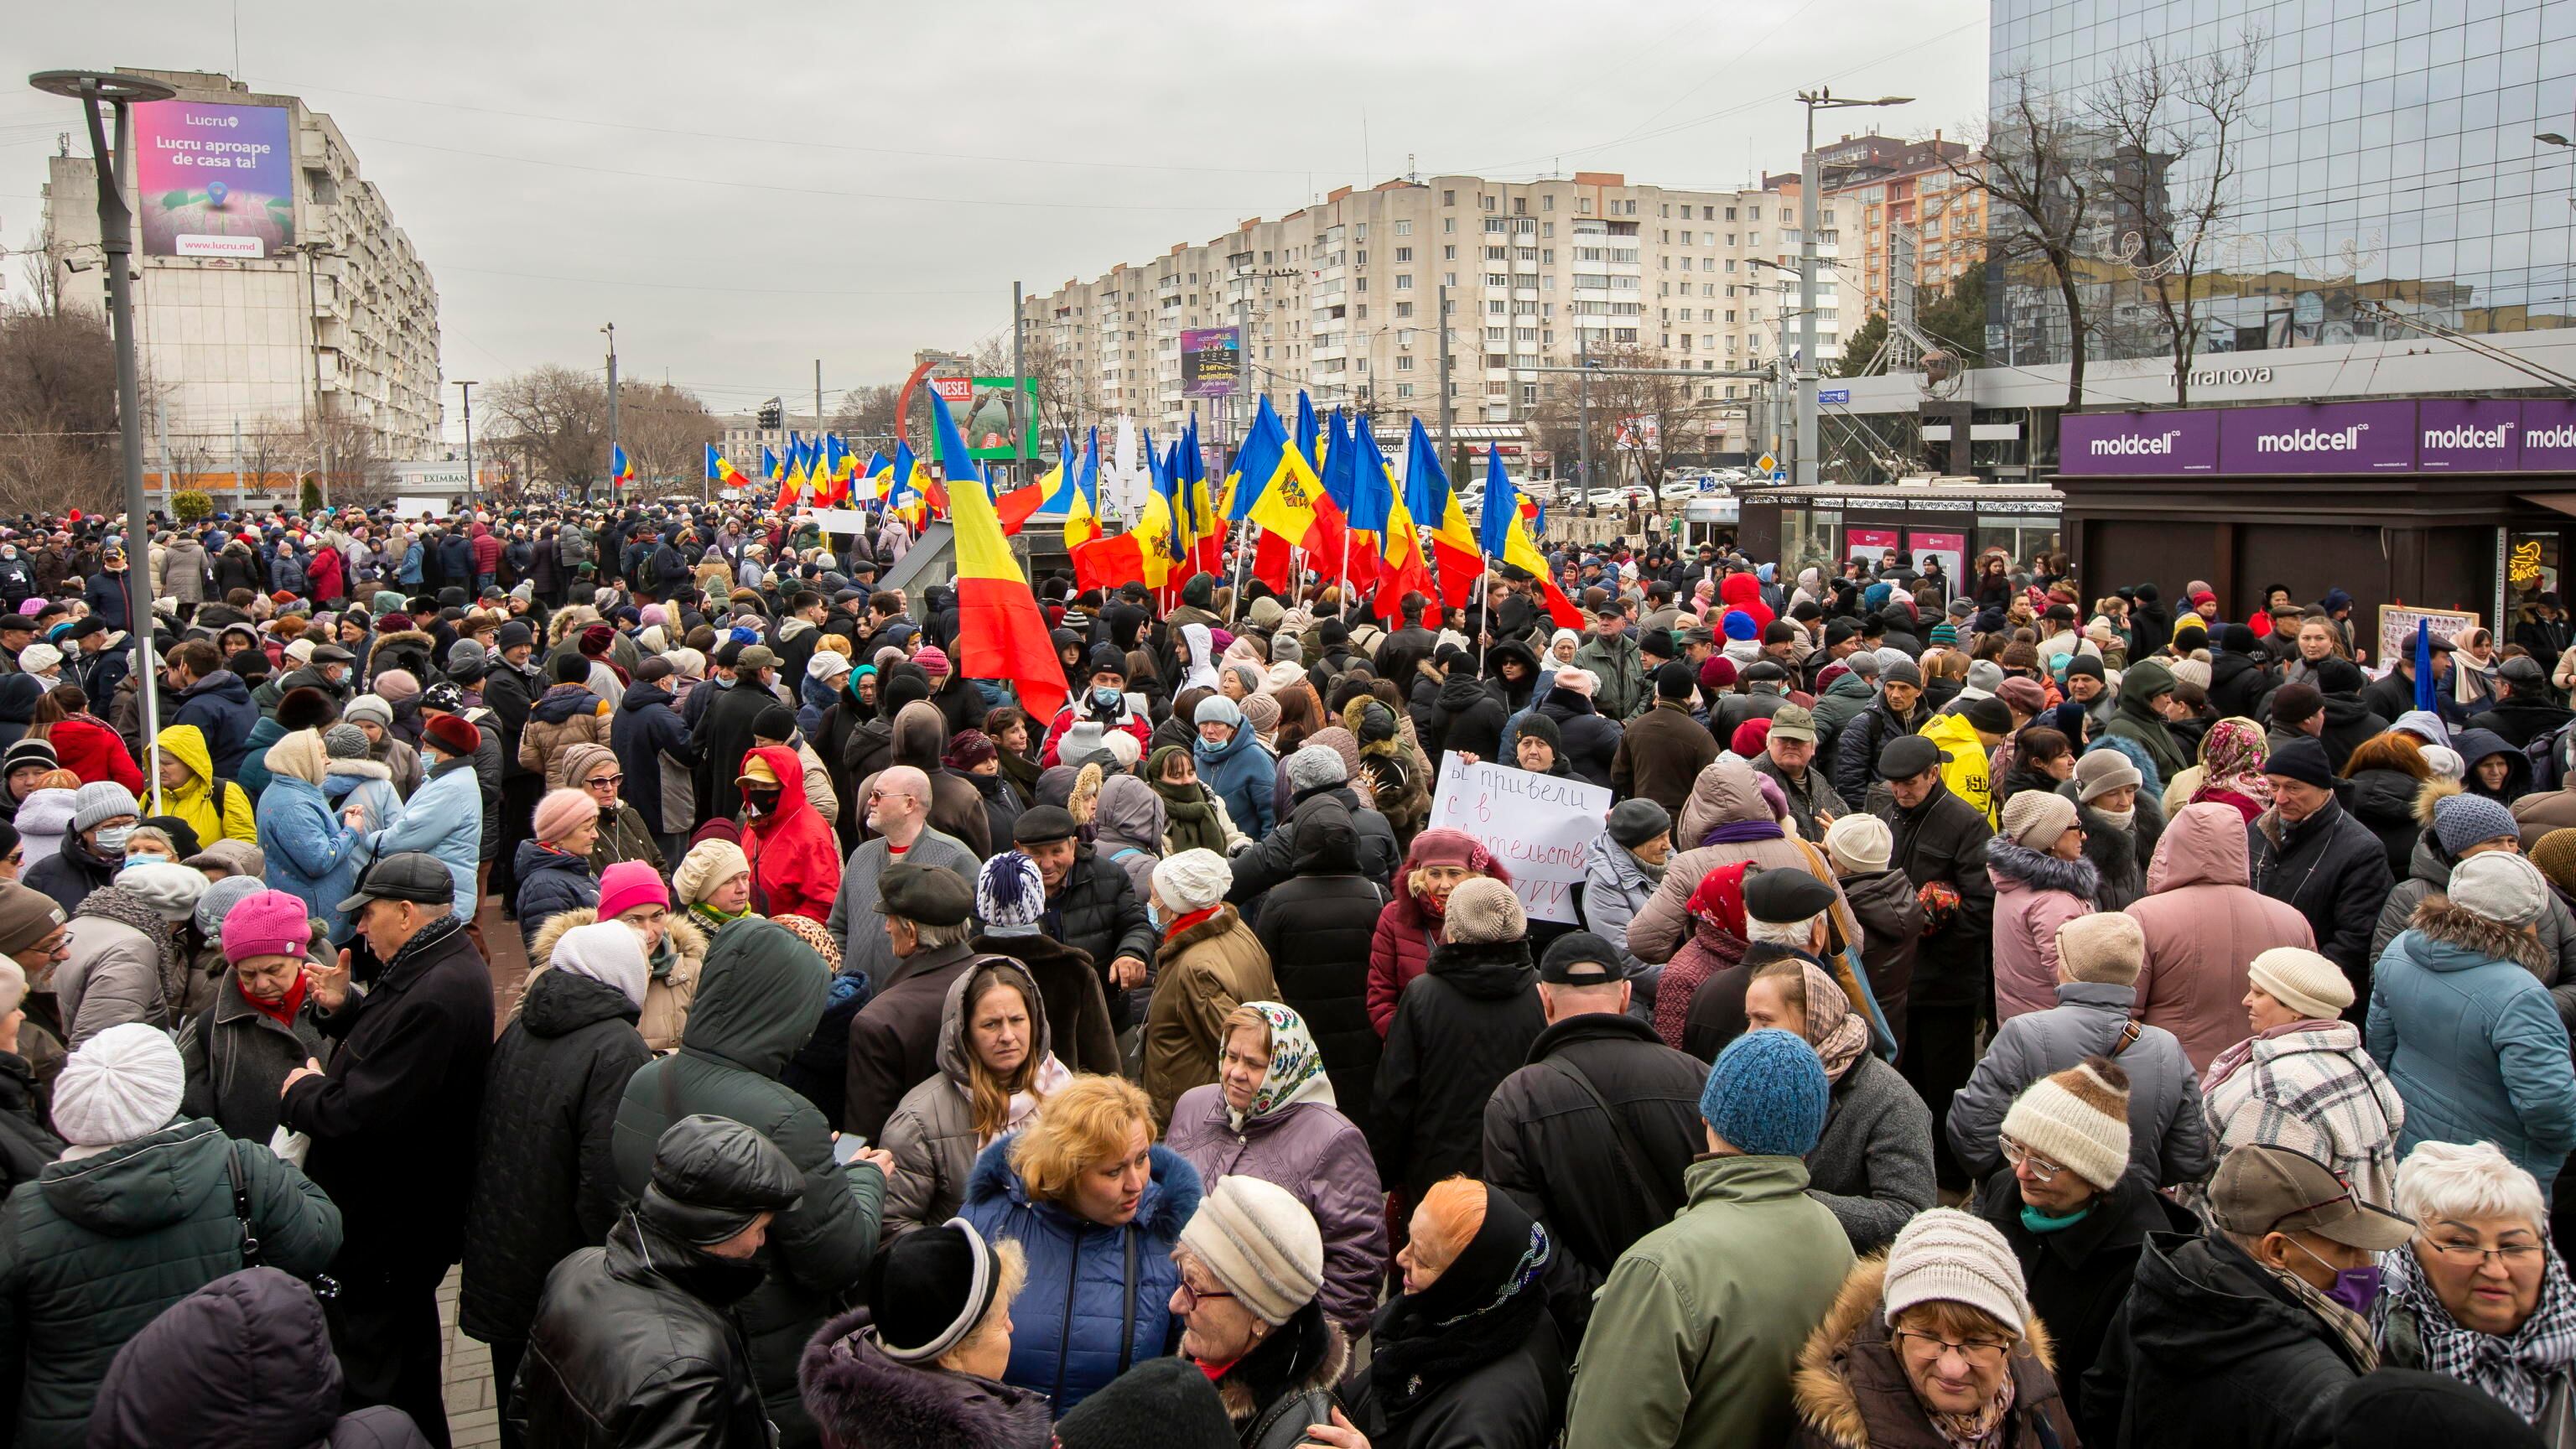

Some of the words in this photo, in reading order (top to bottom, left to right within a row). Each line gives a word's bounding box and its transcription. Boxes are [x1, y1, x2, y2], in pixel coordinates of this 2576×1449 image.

[186, 114, 227, 127] Lucru
[157, 136, 201, 150] Lucru
[205, 141, 271, 156] aproape
[173, 153, 193, 166] de
[197, 157, 231, 168] casa
[236, 155, 257, 169] ta!
[185, 242, 255, 251] www.lucru.md
[2165, 366, 2272, 387] Trranova
[935, 381, 969, 396] DIESEL
[1837, 392, 1846, 401] 65
[2090, 433, 2172, 455] moldcell
[2257, 426, 2357, 452] moldcell
[2424, 424, 2506, 449] moldcell
[423, 474, 475, 483] EXIMBAN
[1481, 770, 1589, 810] привели
[1474, 792, 1491, 822] в
